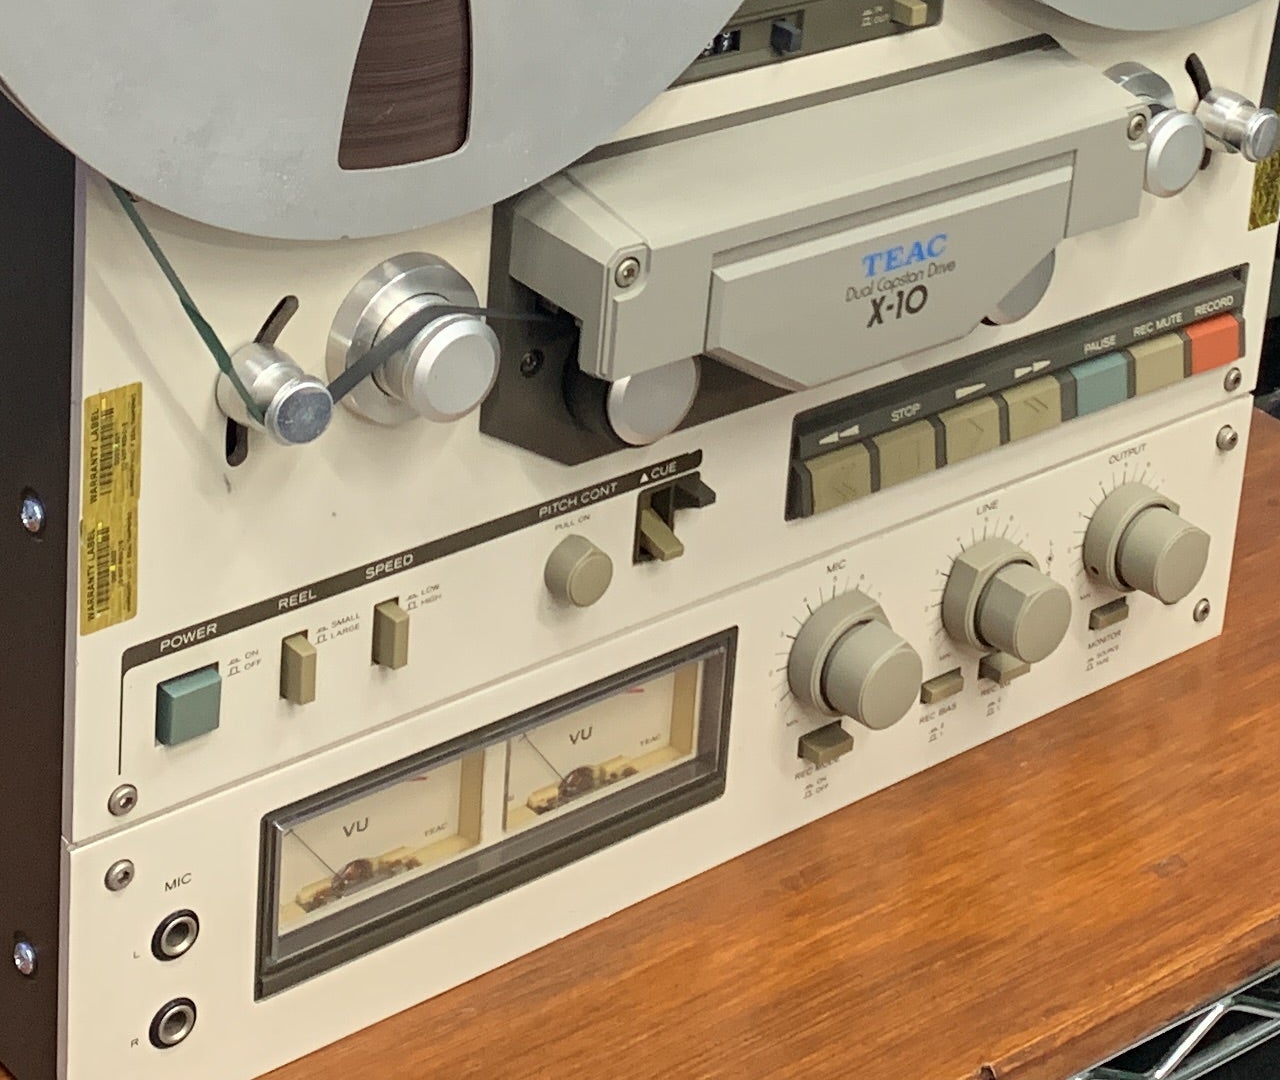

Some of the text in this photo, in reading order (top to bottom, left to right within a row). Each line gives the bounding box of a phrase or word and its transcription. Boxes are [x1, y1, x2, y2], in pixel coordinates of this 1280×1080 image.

[862, 233, 948, 278] TEAC
[845, 260, 957, 303] Dual Capstan Drive
[866, 284, 929, 329] X-10
[1193, 295, 1235, 317] RECORD
[1132, 311, 1184, 338] REC MUTE
[1083, 335, 1117, 355] PAUSE
[890, 402, 921, 422] STOP
[89, 408, 100, 505] WARRANTY LABEL
[1108, 442, 1148, 465] OUTPUT
[650, 461, 678, 480] CUE
[538, 481, 619, 519] PITCH CONT
[975, 499, 1000, 517] LINE
[554, 513, 591, 531] PULL ON
[87, 529, 97, 622] WARRANTY LABEL
[365, 553, 415, 581] SPEED
[825, 558, 848, 575] MIC
[420, 583, 440, 596] LOW
[277, 589, 318, 611] REEL
[420, 593, 443, 607] HIGH
[330, 612, 361, 629] SMALL
[159, 622, 218, 653] POWER
[330, 622, 361, 640] LARGE
[1087, 629, 1123, 650] MONITOR
[243, 658, 263, 671] OFF
[244, 649, 260, 661] ON
[980, 683, 998, 697] REC
[919, 702, 958, 725] REC BIAS
[568, 725, 594, 747] VU
[639, 733, 663, 748] TEAC
[342, 816, 370, 839] VU
[423, 821, 449, 838] TEAC
[163, 872, 193, 893] MIC
[132, 951, 141, 960] L
[130, 1037, 140, 1049] R
